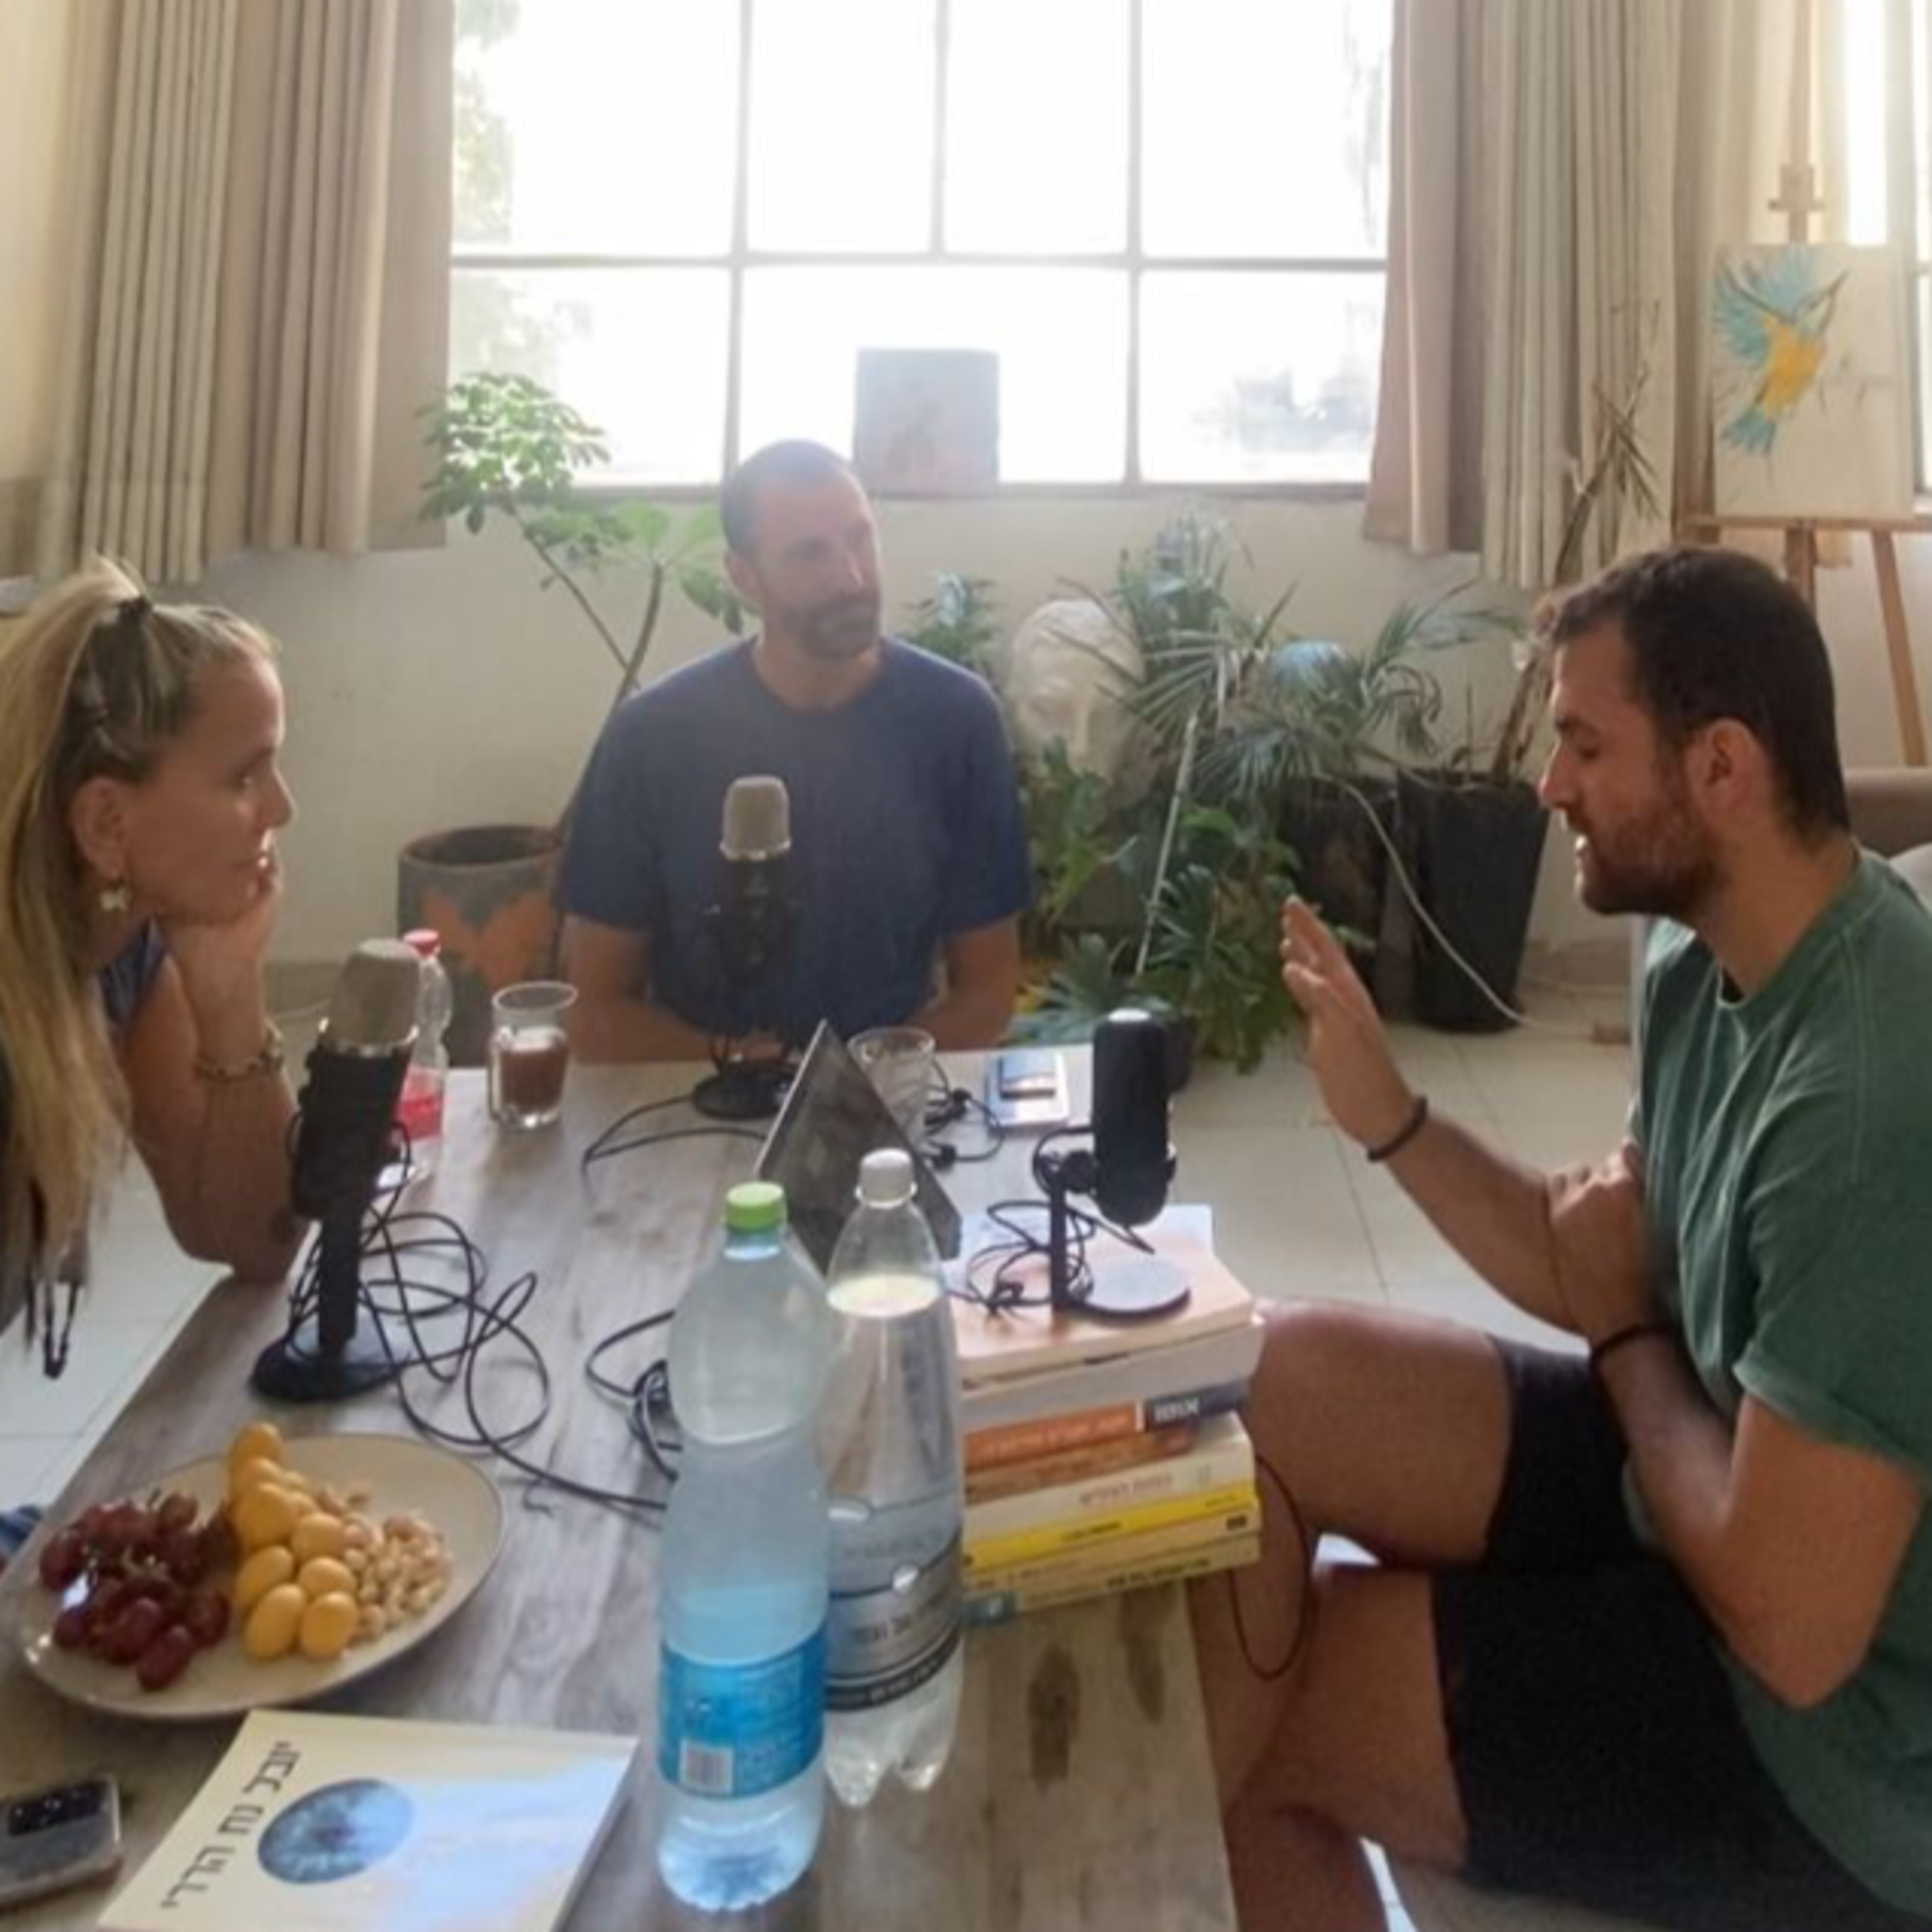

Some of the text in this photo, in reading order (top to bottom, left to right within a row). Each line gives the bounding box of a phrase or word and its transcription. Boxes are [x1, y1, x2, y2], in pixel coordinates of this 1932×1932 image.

[160, 1741, 301, 1908] יובל נח הררי
